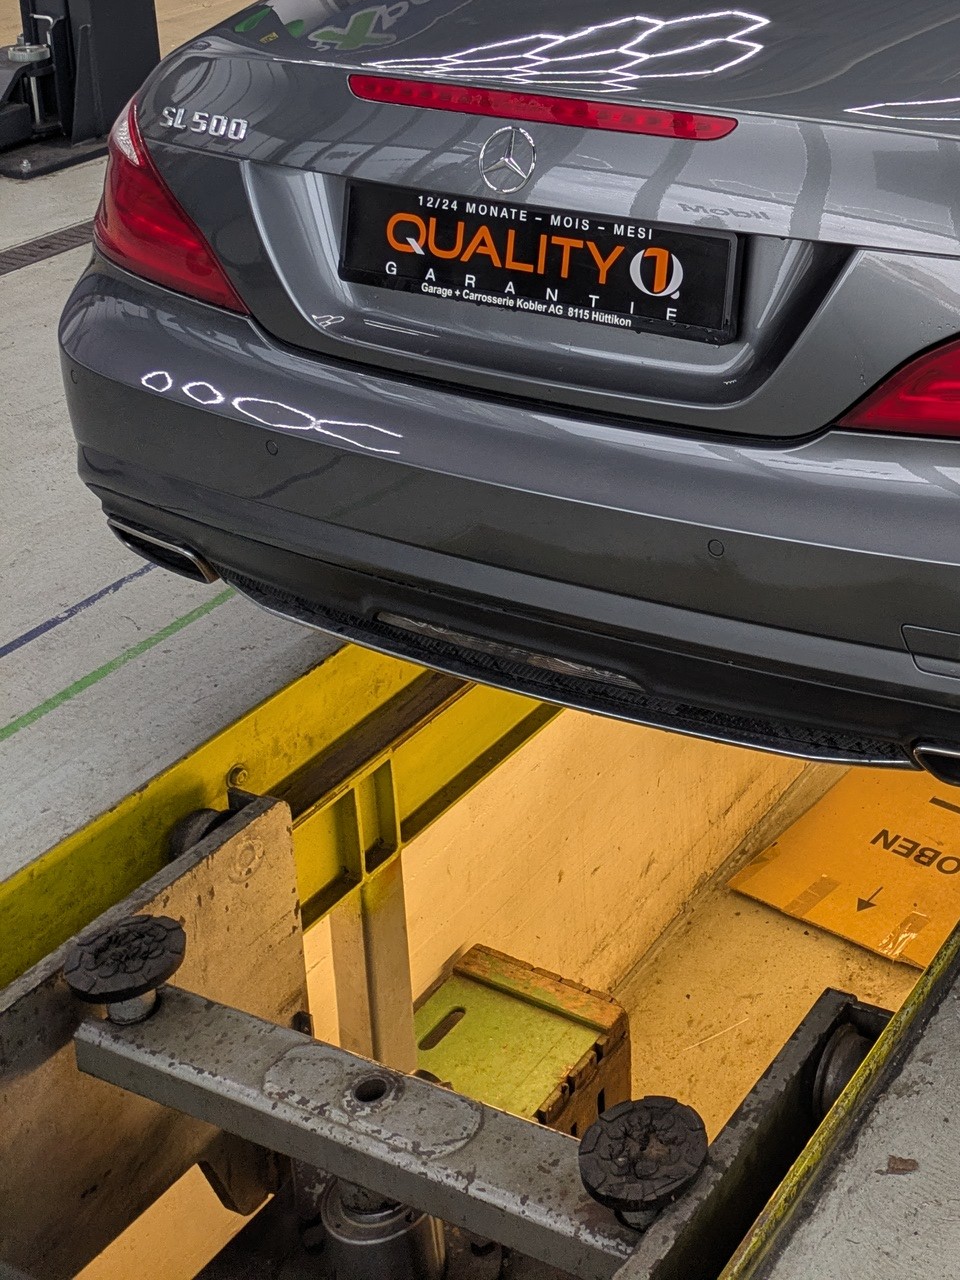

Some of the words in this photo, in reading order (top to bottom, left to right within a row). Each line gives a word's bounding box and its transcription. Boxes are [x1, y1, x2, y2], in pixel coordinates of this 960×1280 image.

[159, 106, 187, 130] SL
[190, 111, 249, 140] 500
[418, 195, 459, 212] 12/24
[465, 201, 528, 222] MONATE
[550, 214, 590, 231] MOIS
[613, 223, 653, 240] MESI
[386, 212, 626, 285] QUALITY
[421, 282, 453, 298] Garage
[462, 289, 515, 307] Carrosserie
[516, 298, 547, 312] Kobler
[547, 303, 564, 316] AG
[567, 307, 590, 320] 8115
[591, 310, 632, 327] Hüttikon
